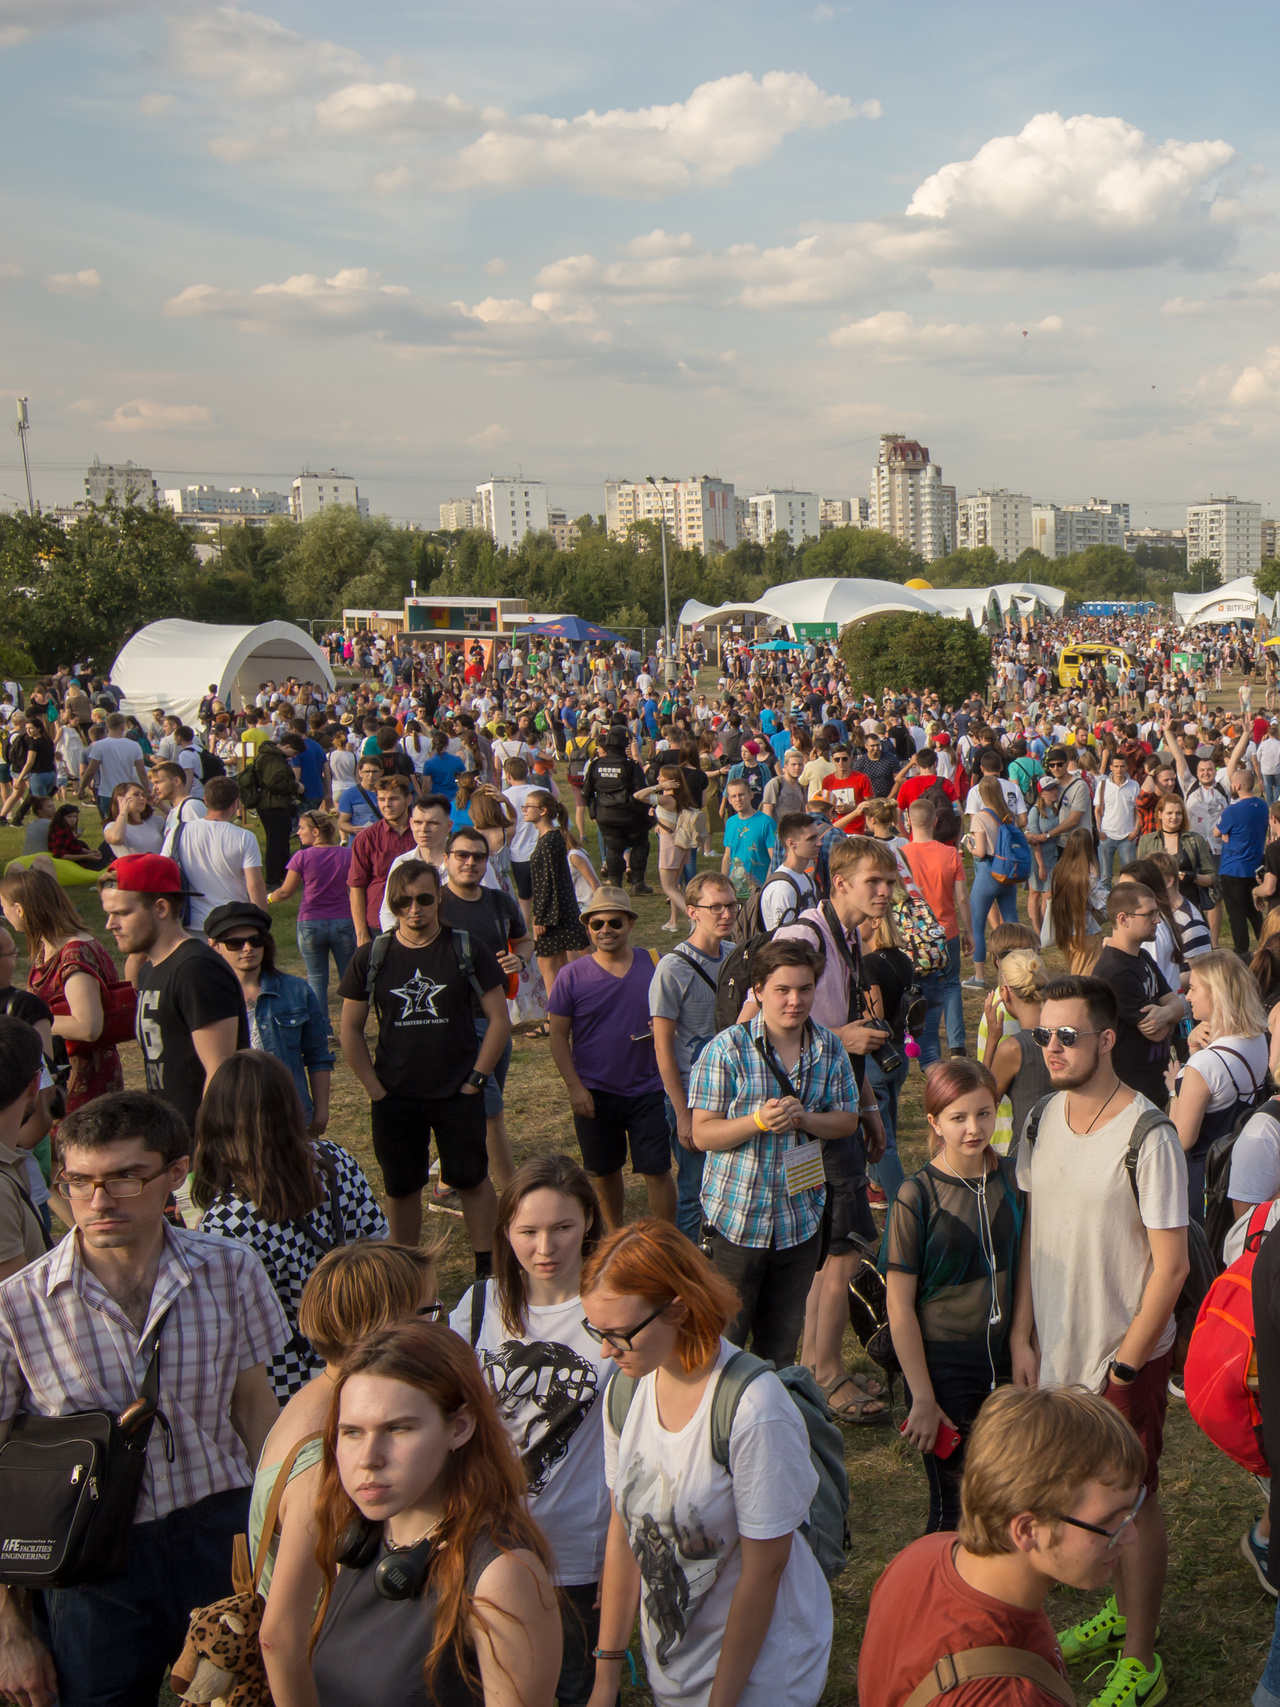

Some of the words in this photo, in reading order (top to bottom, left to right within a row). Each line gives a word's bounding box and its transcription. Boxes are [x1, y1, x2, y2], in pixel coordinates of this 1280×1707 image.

[1226, 604, 1255, 612] BITFURY
[19, 1545, 53, 1553] FACILITIES
[387, 1567, 408, 1590] JBL
